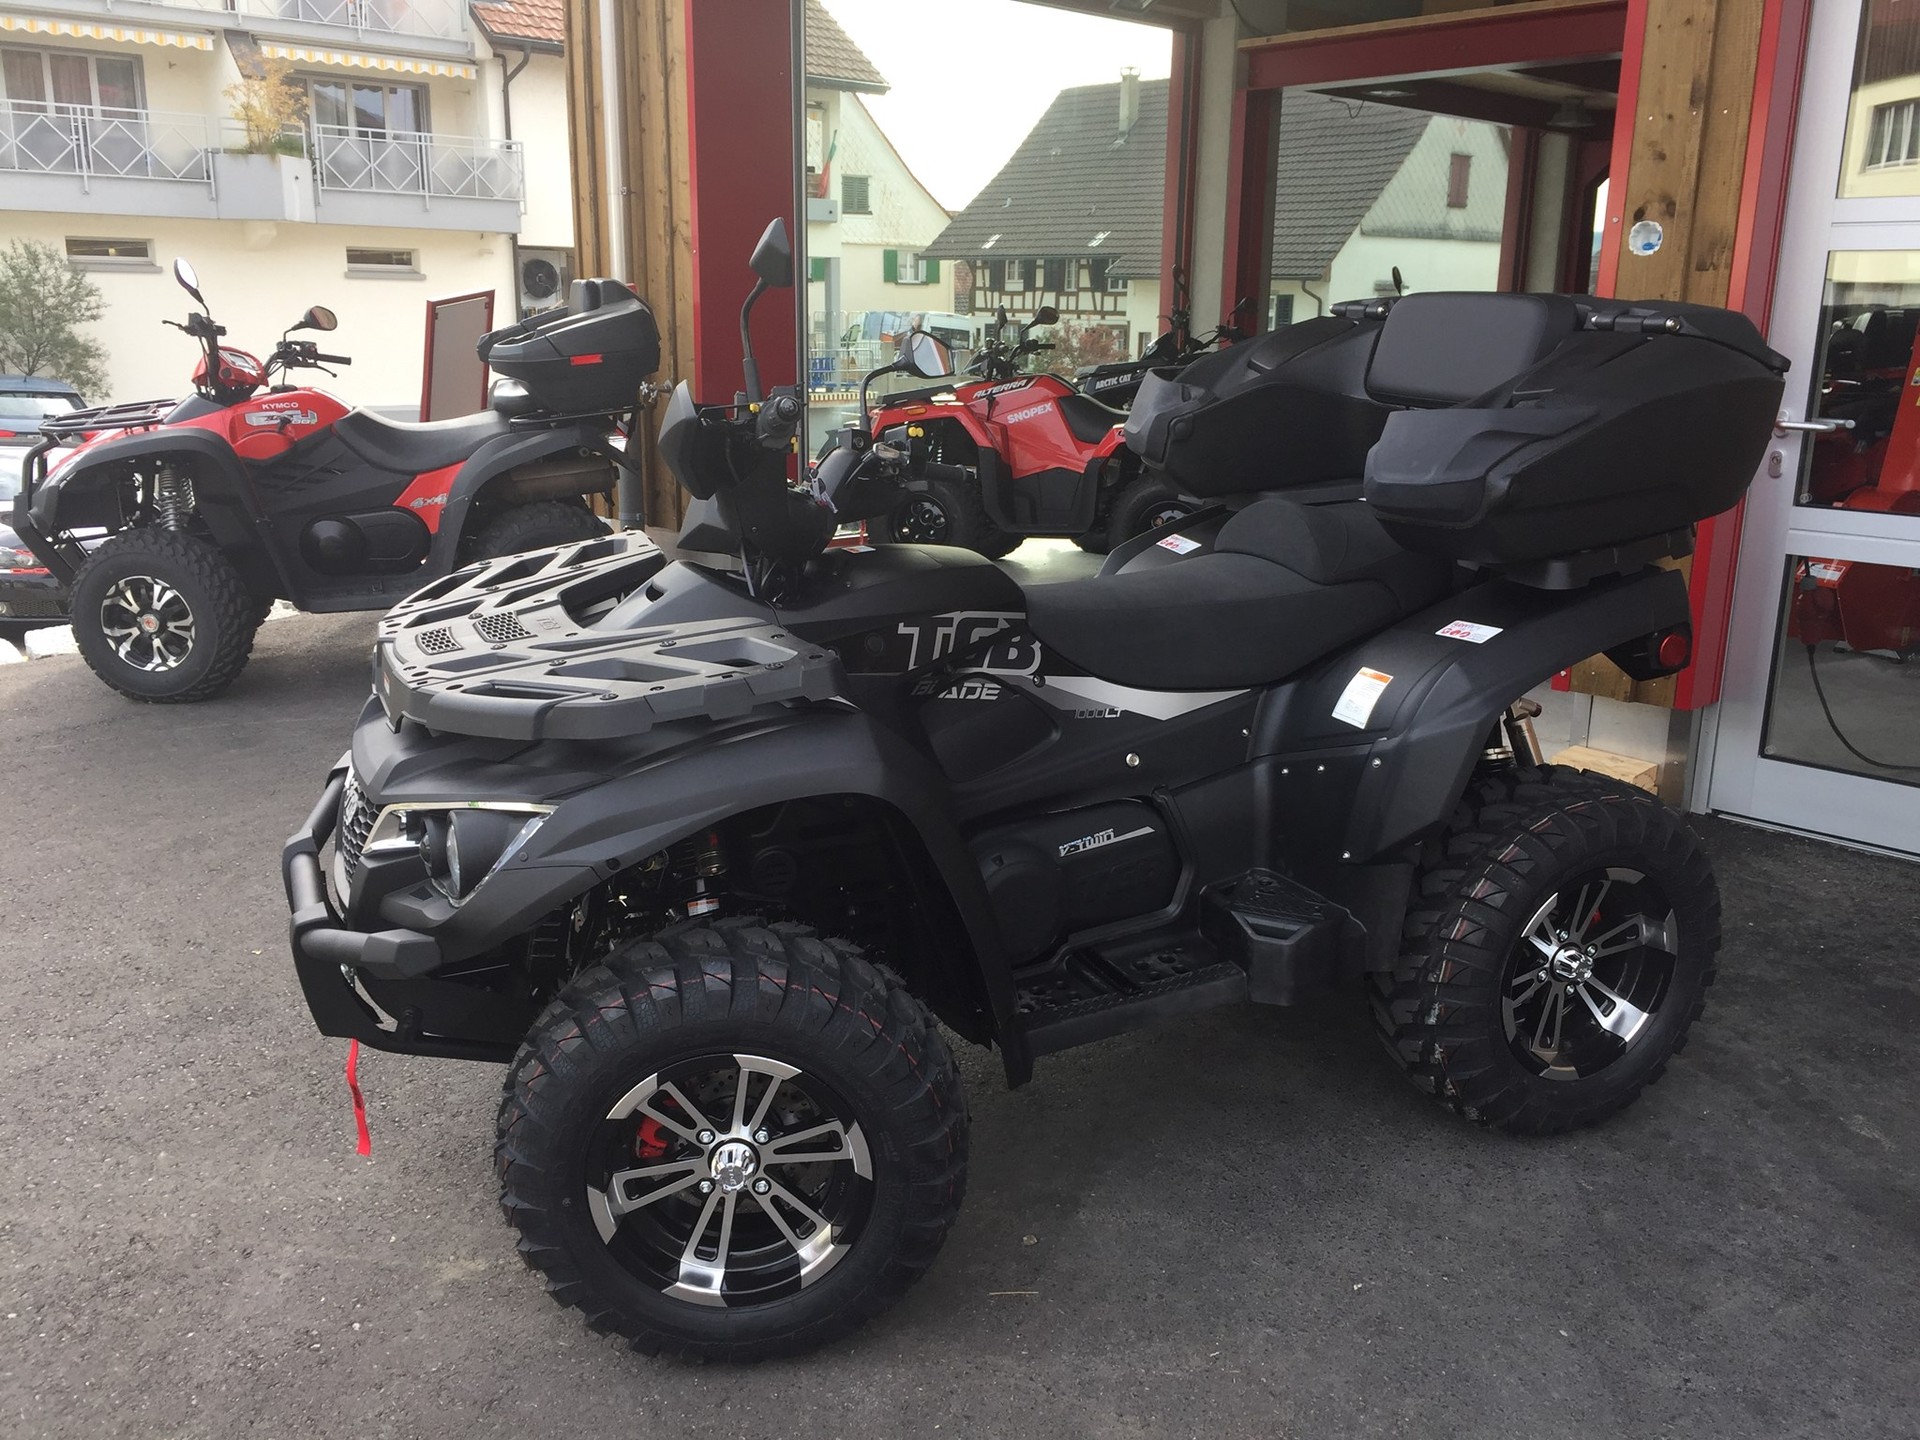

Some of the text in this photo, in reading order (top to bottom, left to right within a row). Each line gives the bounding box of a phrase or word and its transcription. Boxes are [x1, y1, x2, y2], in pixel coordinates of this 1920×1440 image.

[972, 379, 1028, 399] ALTERRA
[1095, 373, 1132, 390] ARCTIC CAT
[262, 402, 299, 410] KYMCO
[1007, 402, 1052, 424] SNOPEX
[897, 610, 1042, 676] TGB
[911, 681, 1002, 700] BLADE
